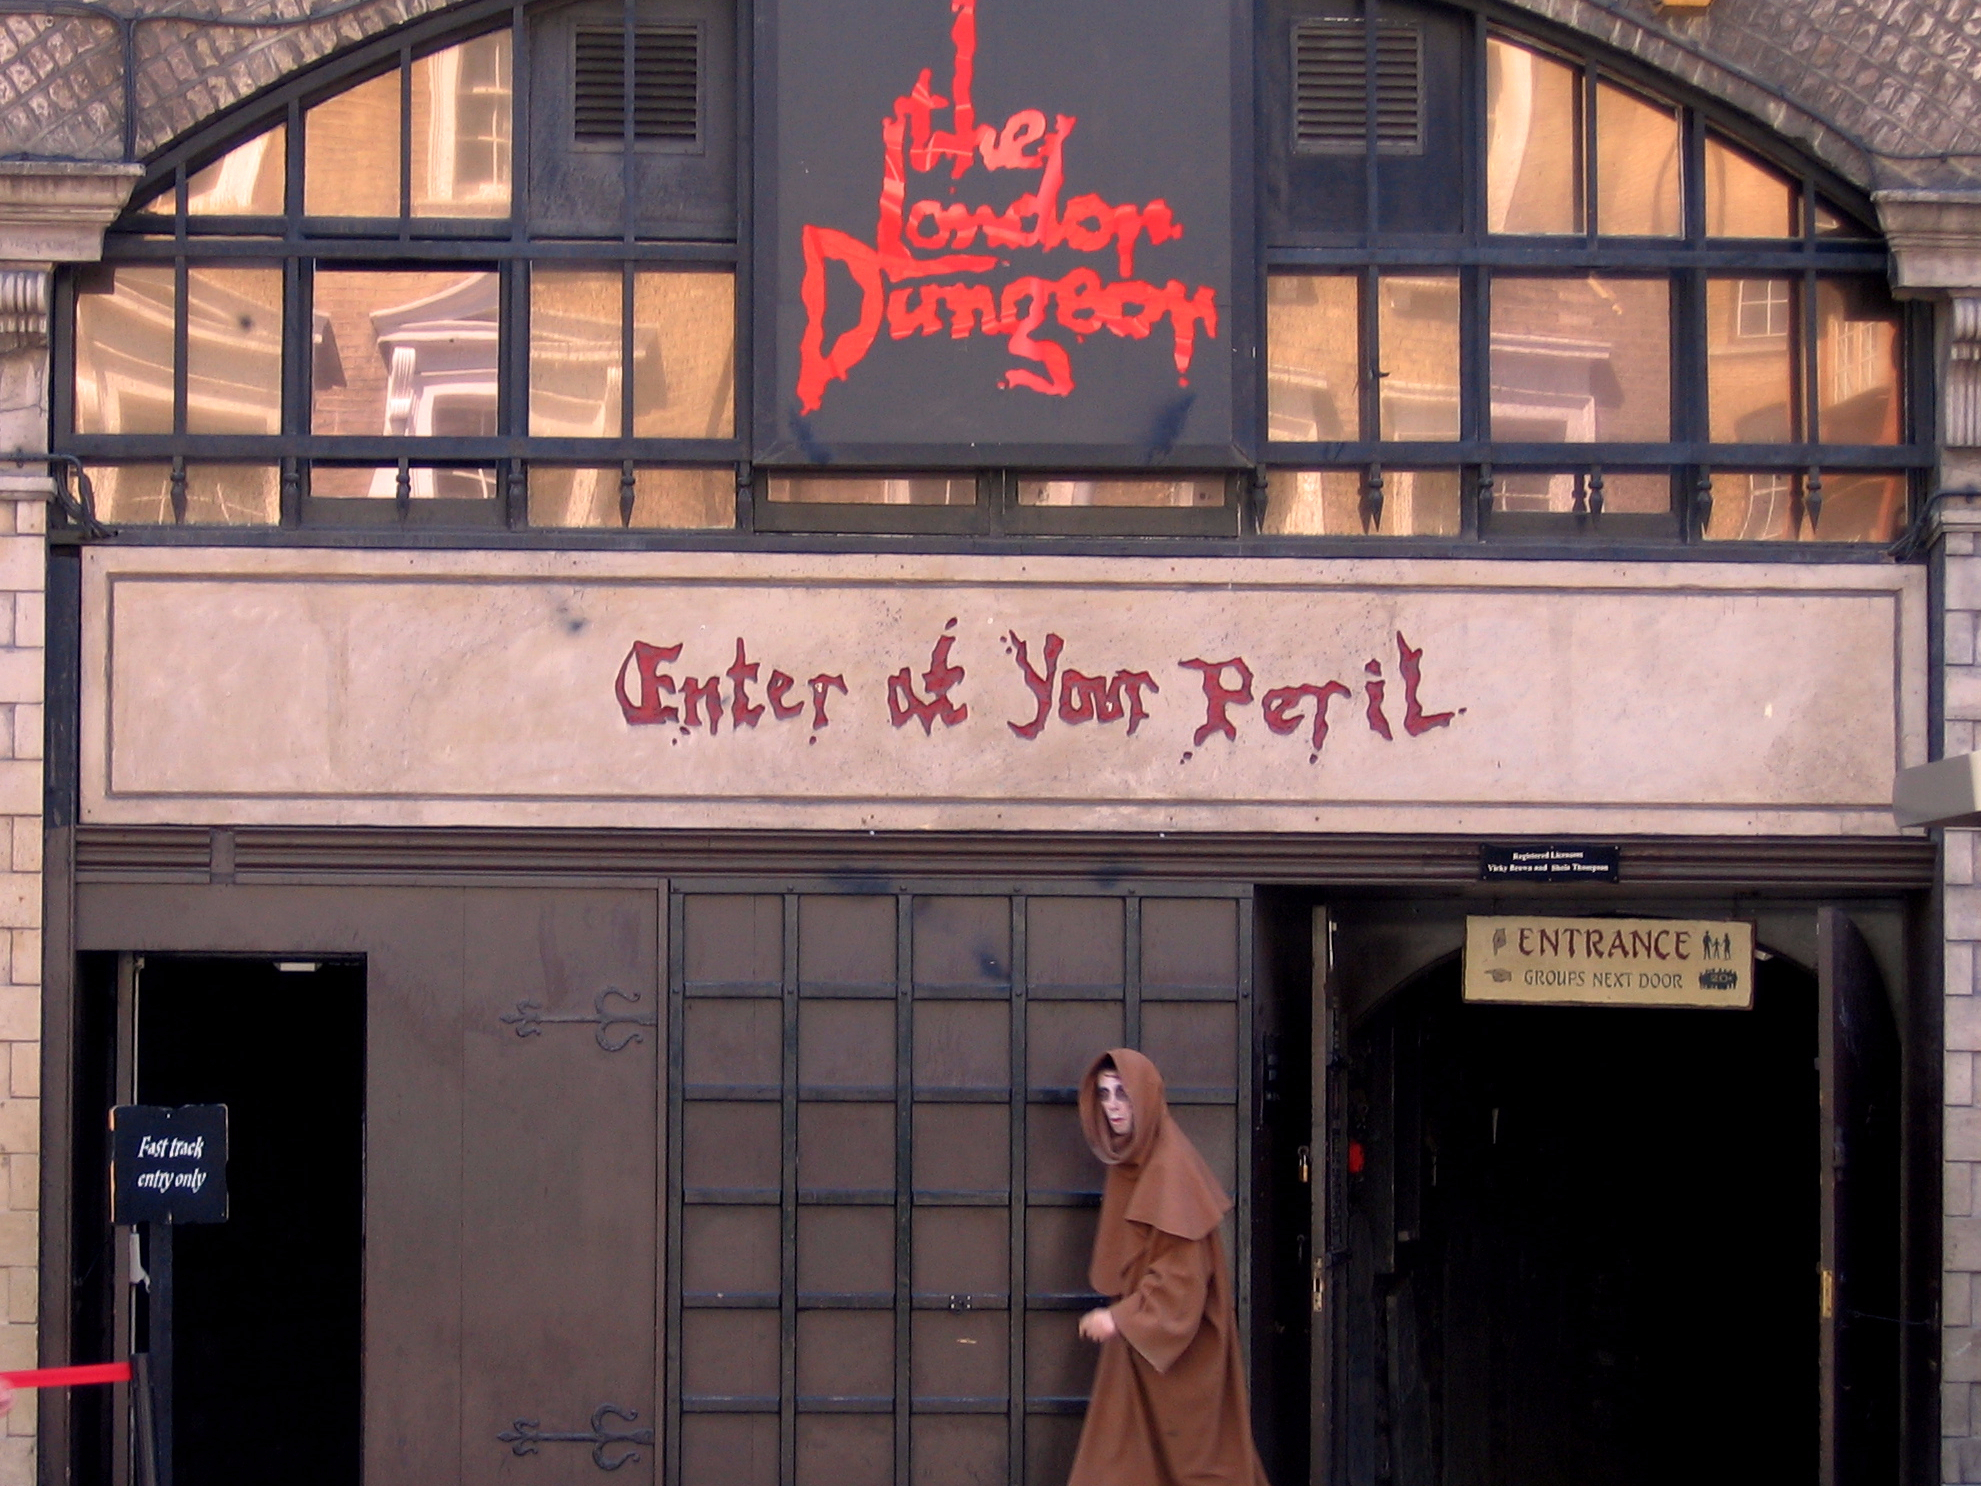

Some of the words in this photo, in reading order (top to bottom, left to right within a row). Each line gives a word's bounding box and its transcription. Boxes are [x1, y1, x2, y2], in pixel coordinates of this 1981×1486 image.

[877, 113, 1184, 283] London
[797, 224, 1217, 416] Dungeon
[615, 636, 848, 738] Enter
[887, 617, 968, 737] at
[1001, 630, 1160, 740] Your
[1177, 630, 1467, 765] Peril
[1533, 863, 1548, 872] and
[1518, 927, 1691, 960] ENTRANCE
[1523, 969, 1585, 986] GROUPS
[1592, 972, 1632, 988] NEXT
[1638, 973, 1683, 989] DOOR
[137, 1135, 169, 1158] Fast
[169, 1136, 205, 1159] track
[137, 1169, 175, 1194] entry
[174, 1168, 207, 1194] only
